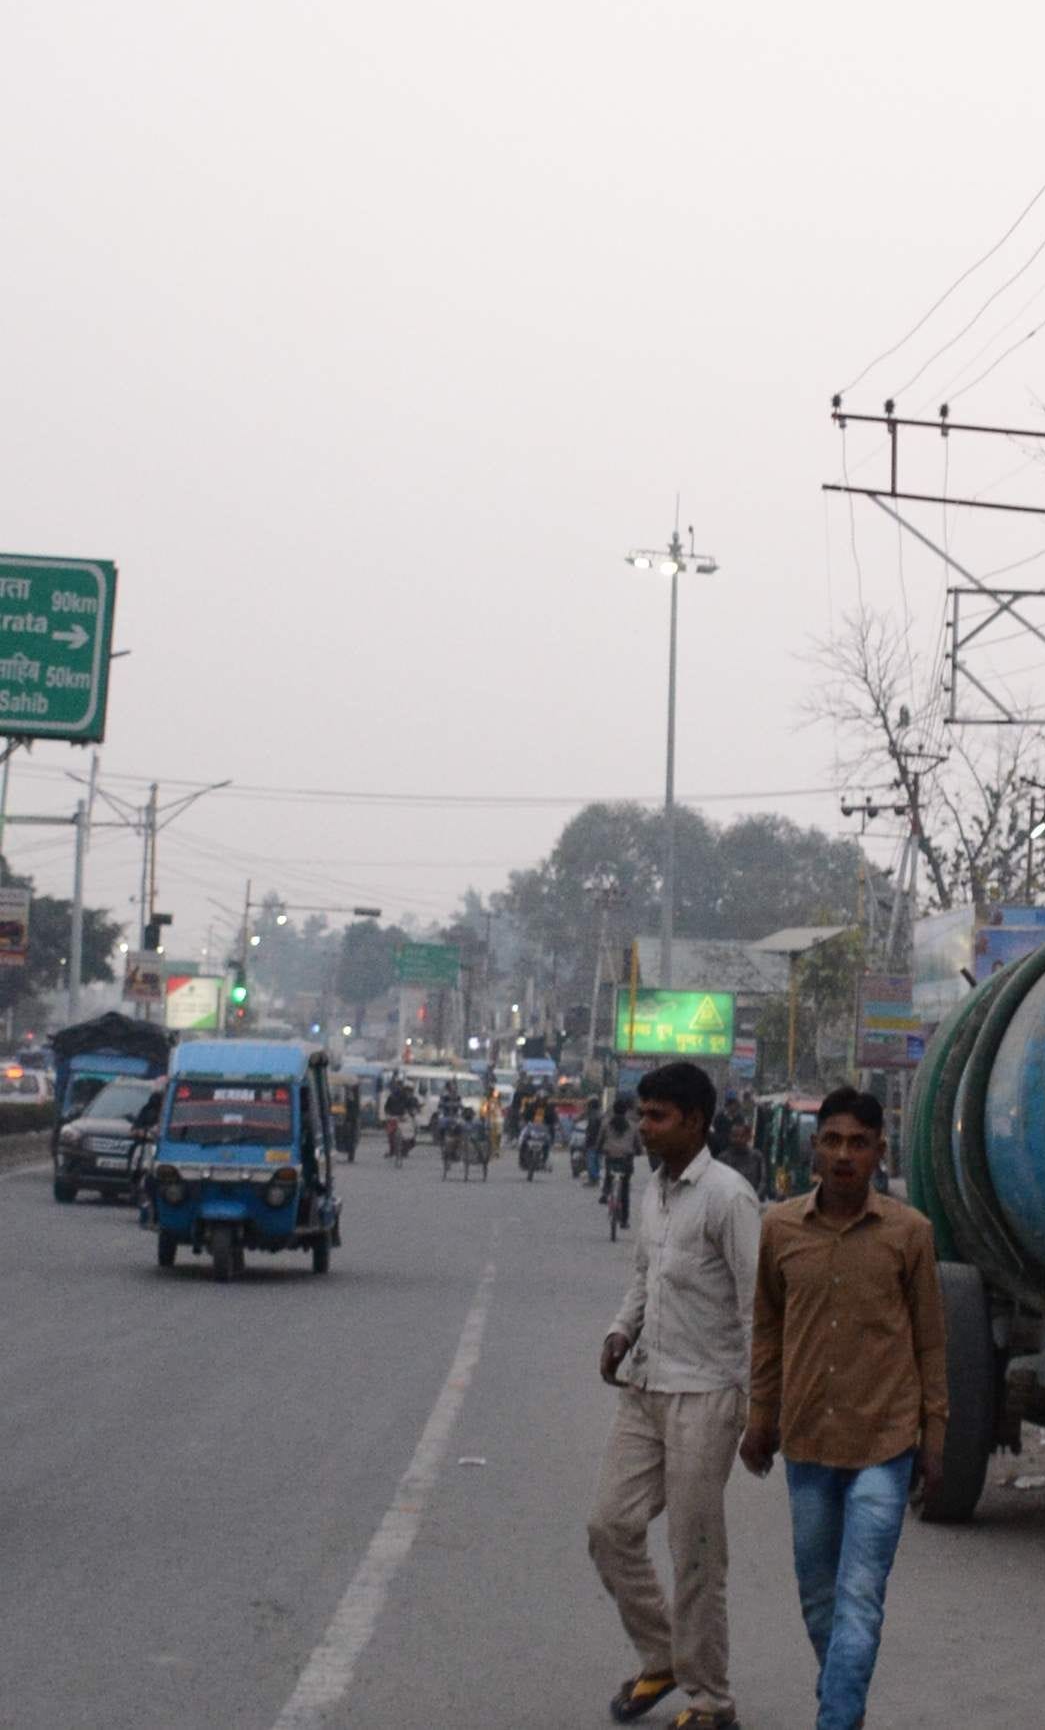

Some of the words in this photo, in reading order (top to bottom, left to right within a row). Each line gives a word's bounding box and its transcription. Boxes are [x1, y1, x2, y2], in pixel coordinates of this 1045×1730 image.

[51, 590, 97, 613] 90km
[0, 612, 47, 634] rata
[46, 666, 90, 689] 50km
[0, 689, 48, 713] Sahib
